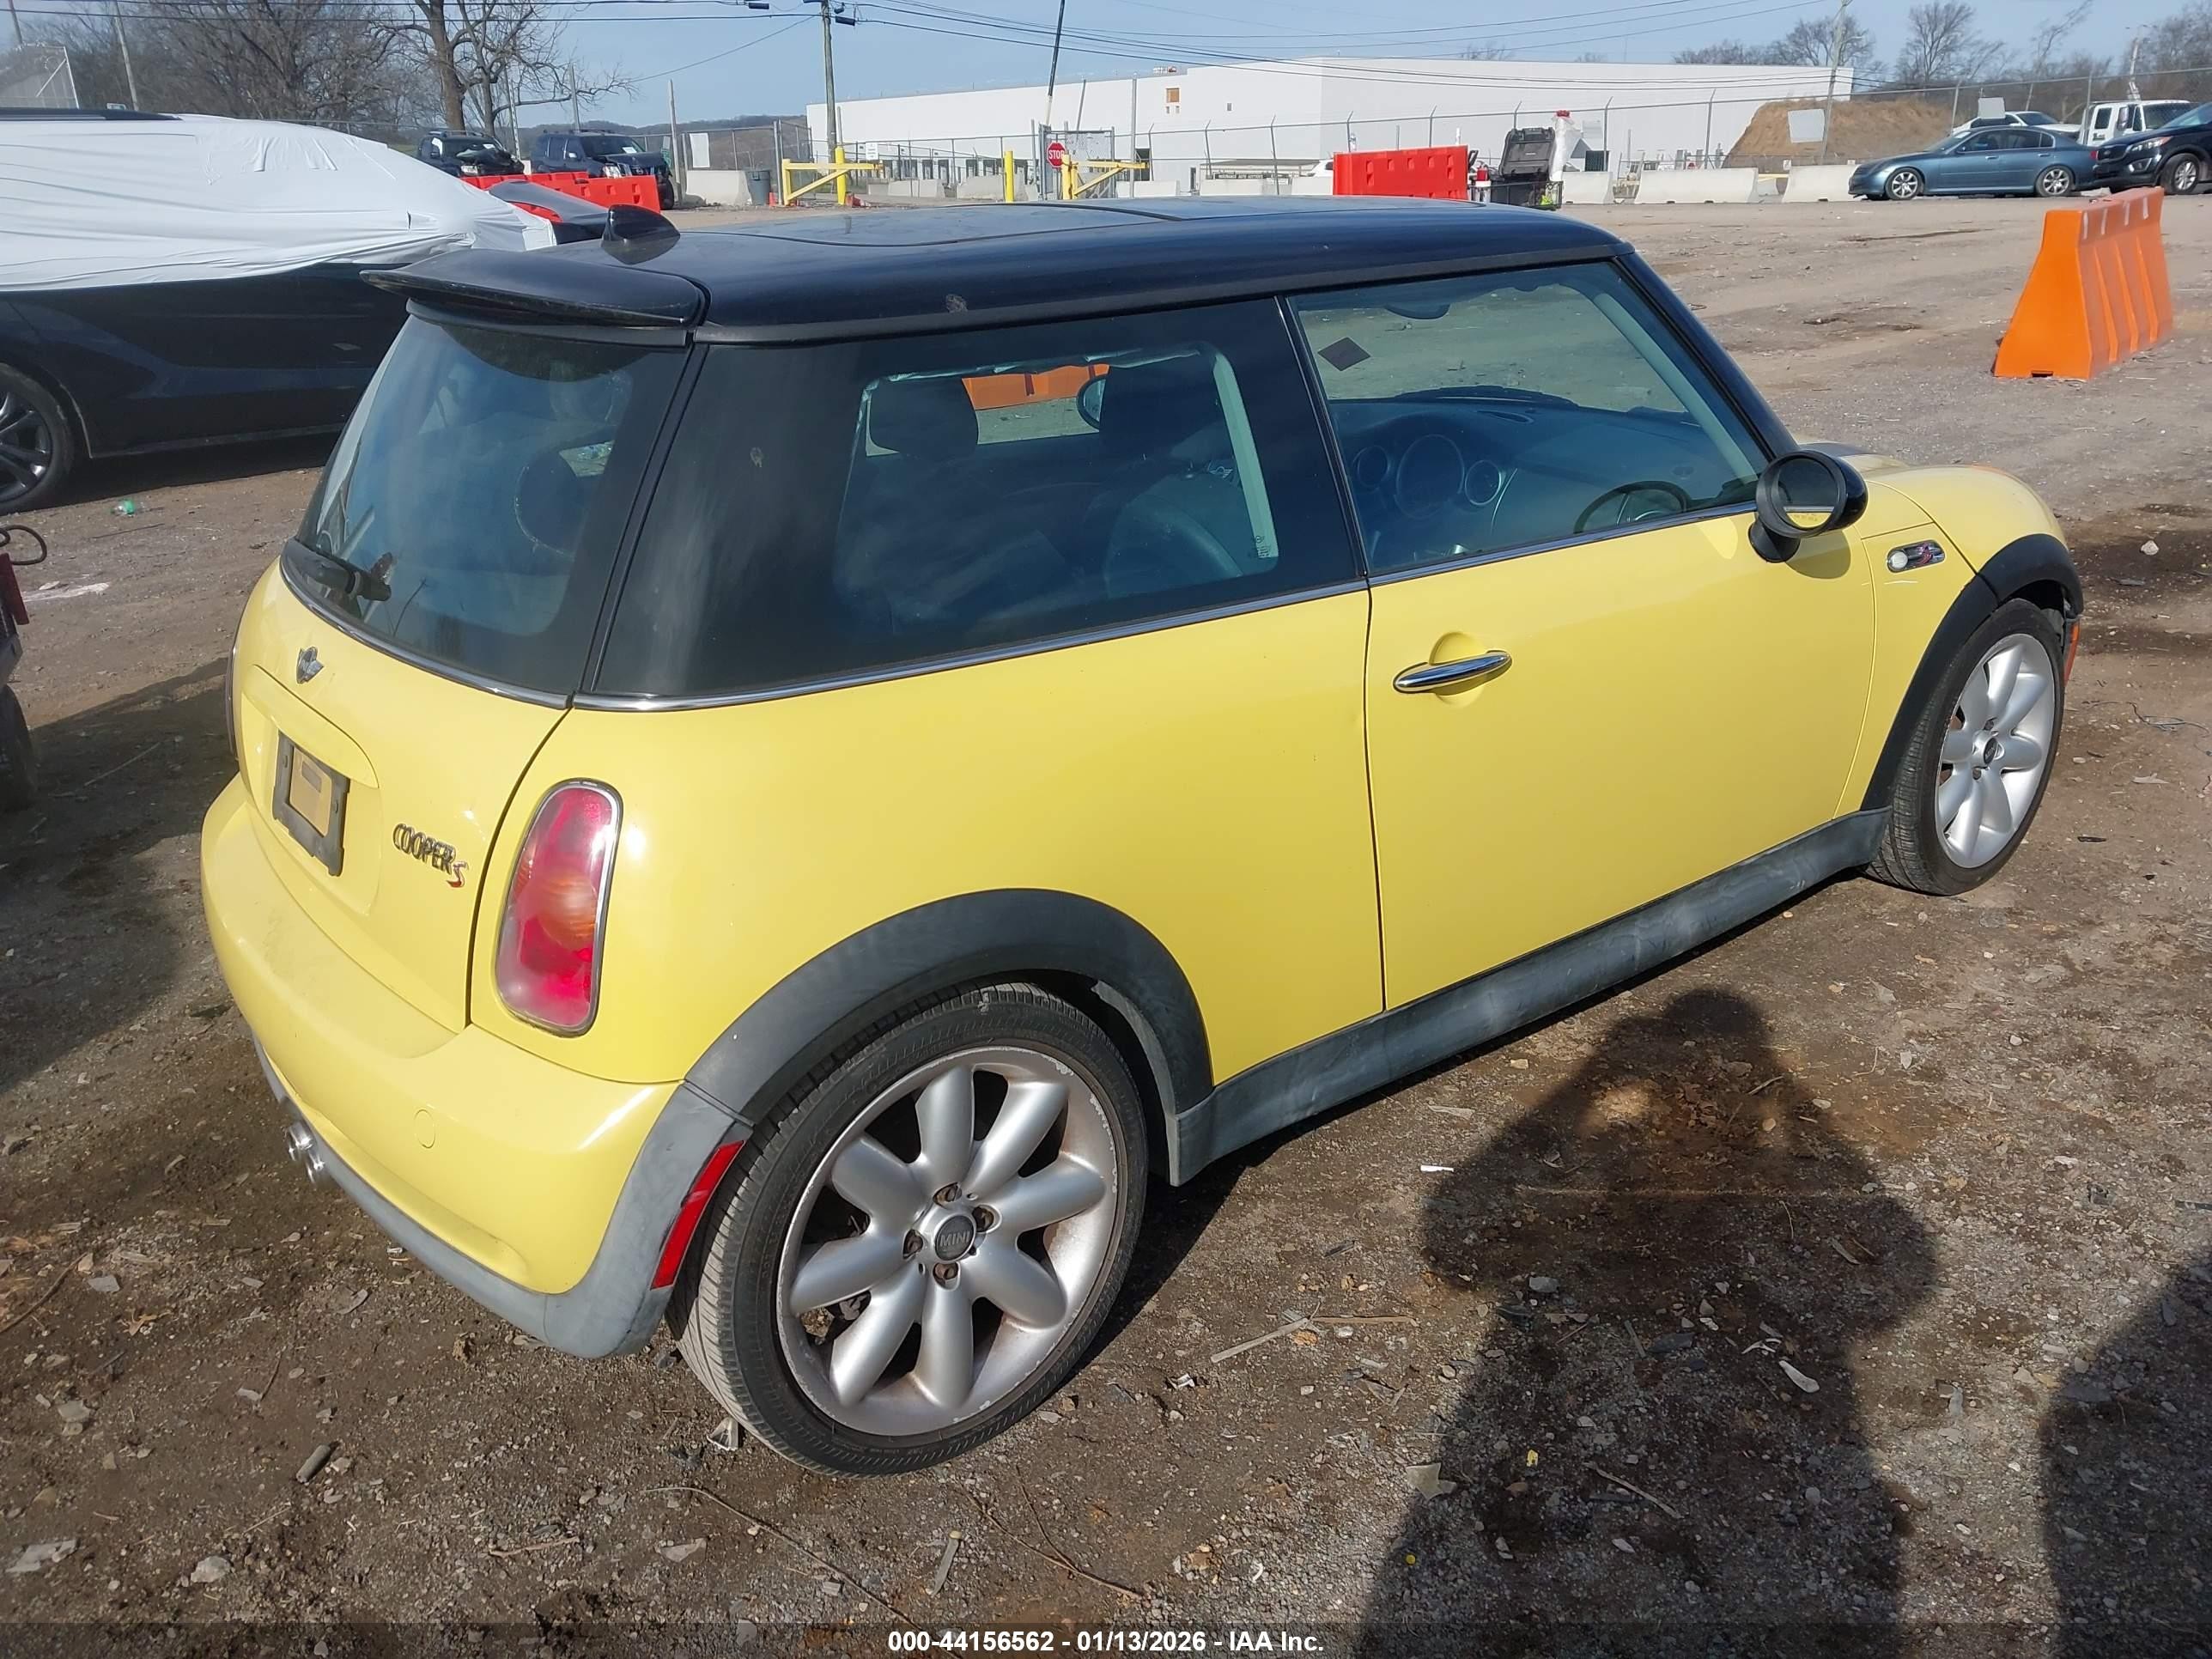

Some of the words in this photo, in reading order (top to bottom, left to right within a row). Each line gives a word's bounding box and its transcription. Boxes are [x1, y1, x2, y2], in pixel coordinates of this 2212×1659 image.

[393, 823, 456, 874] COOPER
[447, 860, 469, 888] S
[940, 1231, 969, 1247] MINI
